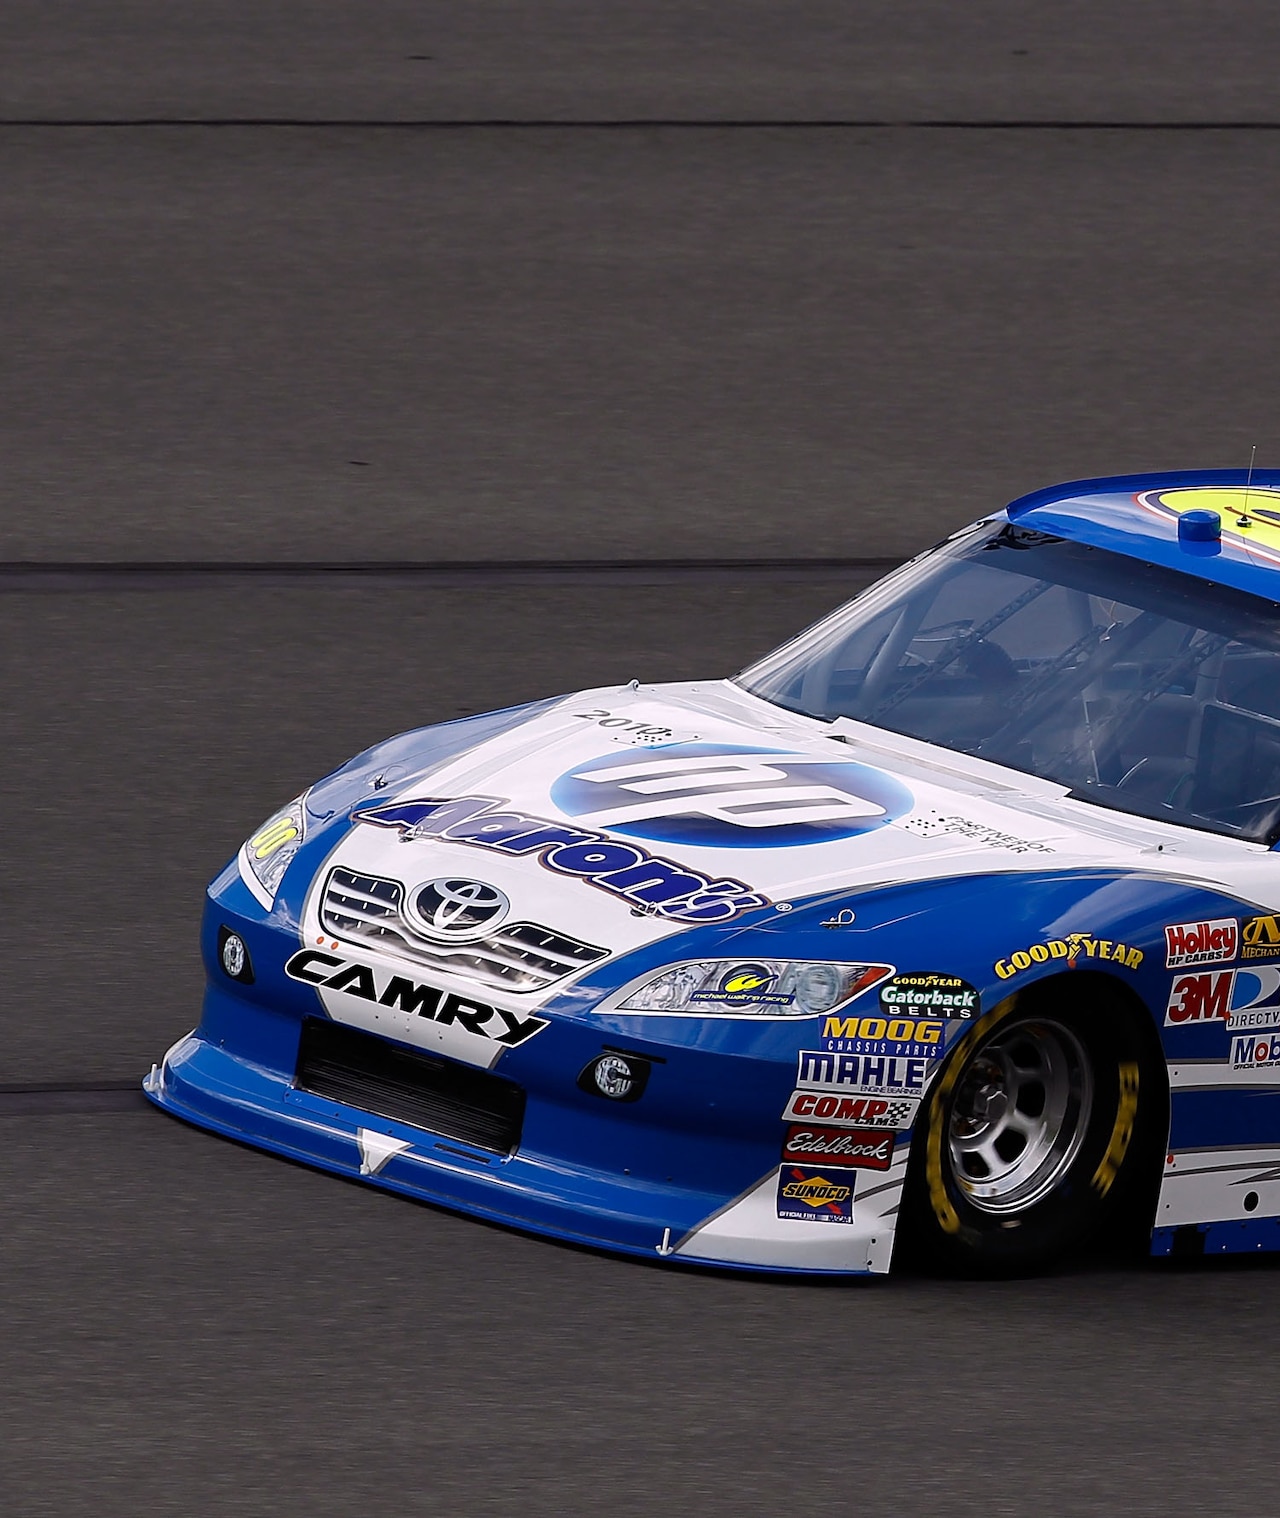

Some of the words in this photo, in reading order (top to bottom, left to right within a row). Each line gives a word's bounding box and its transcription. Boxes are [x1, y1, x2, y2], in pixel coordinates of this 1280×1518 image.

[571, 709, 672, 735] 2010
[568, 753, 888, 829] hp
[353, 797, 770, 924] Aaron's
[1167, 924, 1236, 959] Holley
[1168, 956, 1184, 966] HP
[1184, 951, 1225, 964] CARBS
[285, 949, 550, 1047] CAMRY
[693, 992, 727, 1001] michael
[760, 994, 790, 1004] racing
[881, 985, 978, 1007] Gatorback
[1168, 971, 1235, 1023] 3M
[888, 1005, 972, 1019] BELTS
[1227, 1011, 1280, 1027] DIRECTV
[822, 1016, 944, 1044] MOOG
[827, 1040, 887, 1054] CHASSIS
[895, 1044, 937, 1057] PARTS
[799, 1052, 926, 1089] MAHLE
[860, 1085, 886, 1094] ENGINE
[791, 1094, 889, 1121] COMP
[854, 1115, 900, 1127] CAMS
[786, 1132, 890, 1161] Edelbrock
[784, 1184, 848, 1200] SUNOCO
